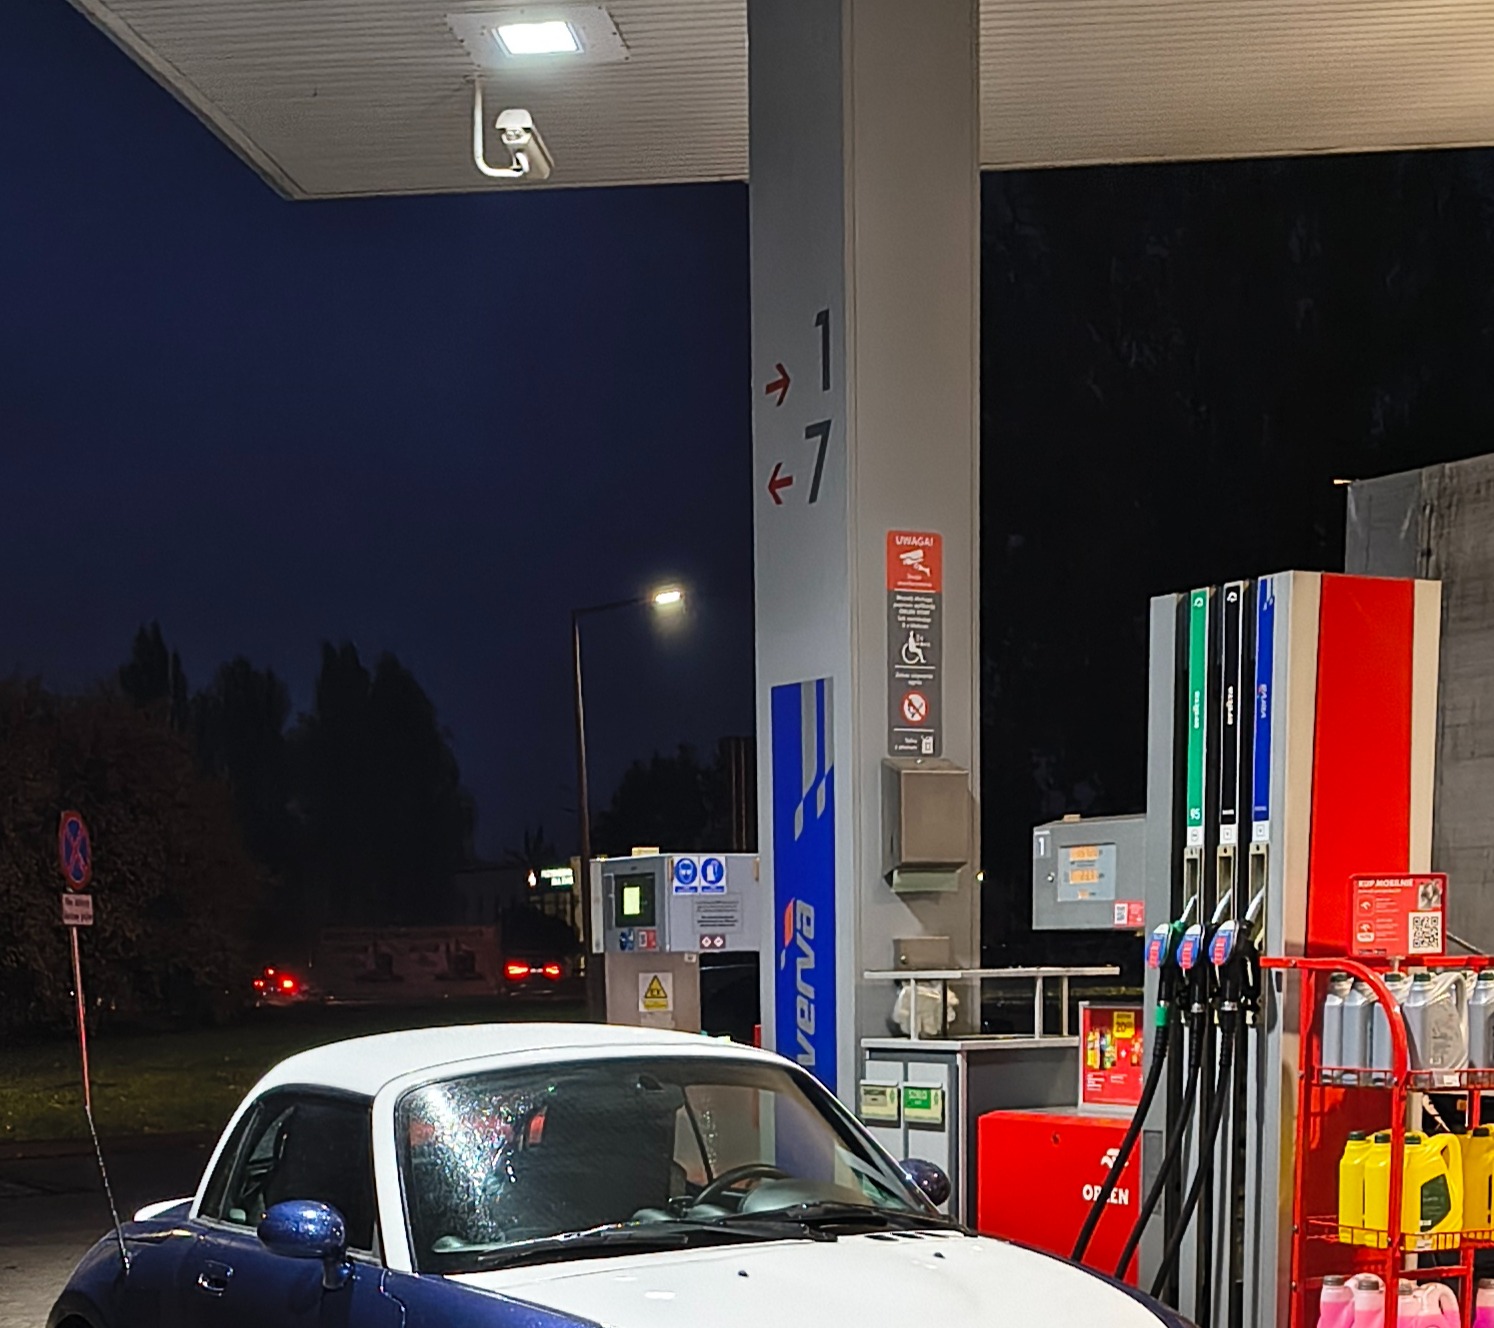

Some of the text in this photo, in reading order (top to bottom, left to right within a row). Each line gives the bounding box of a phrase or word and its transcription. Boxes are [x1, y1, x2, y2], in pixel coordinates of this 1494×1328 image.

[815, 308, 830, 392] 1
[805, 420, 832, 504] 7
[895, 536, 934, 547] UWAGA!
[1190, 808, 1201, 821] 95
[1038, 837, 1045, 857] 1
[796, 899, 816, 1067] verva
